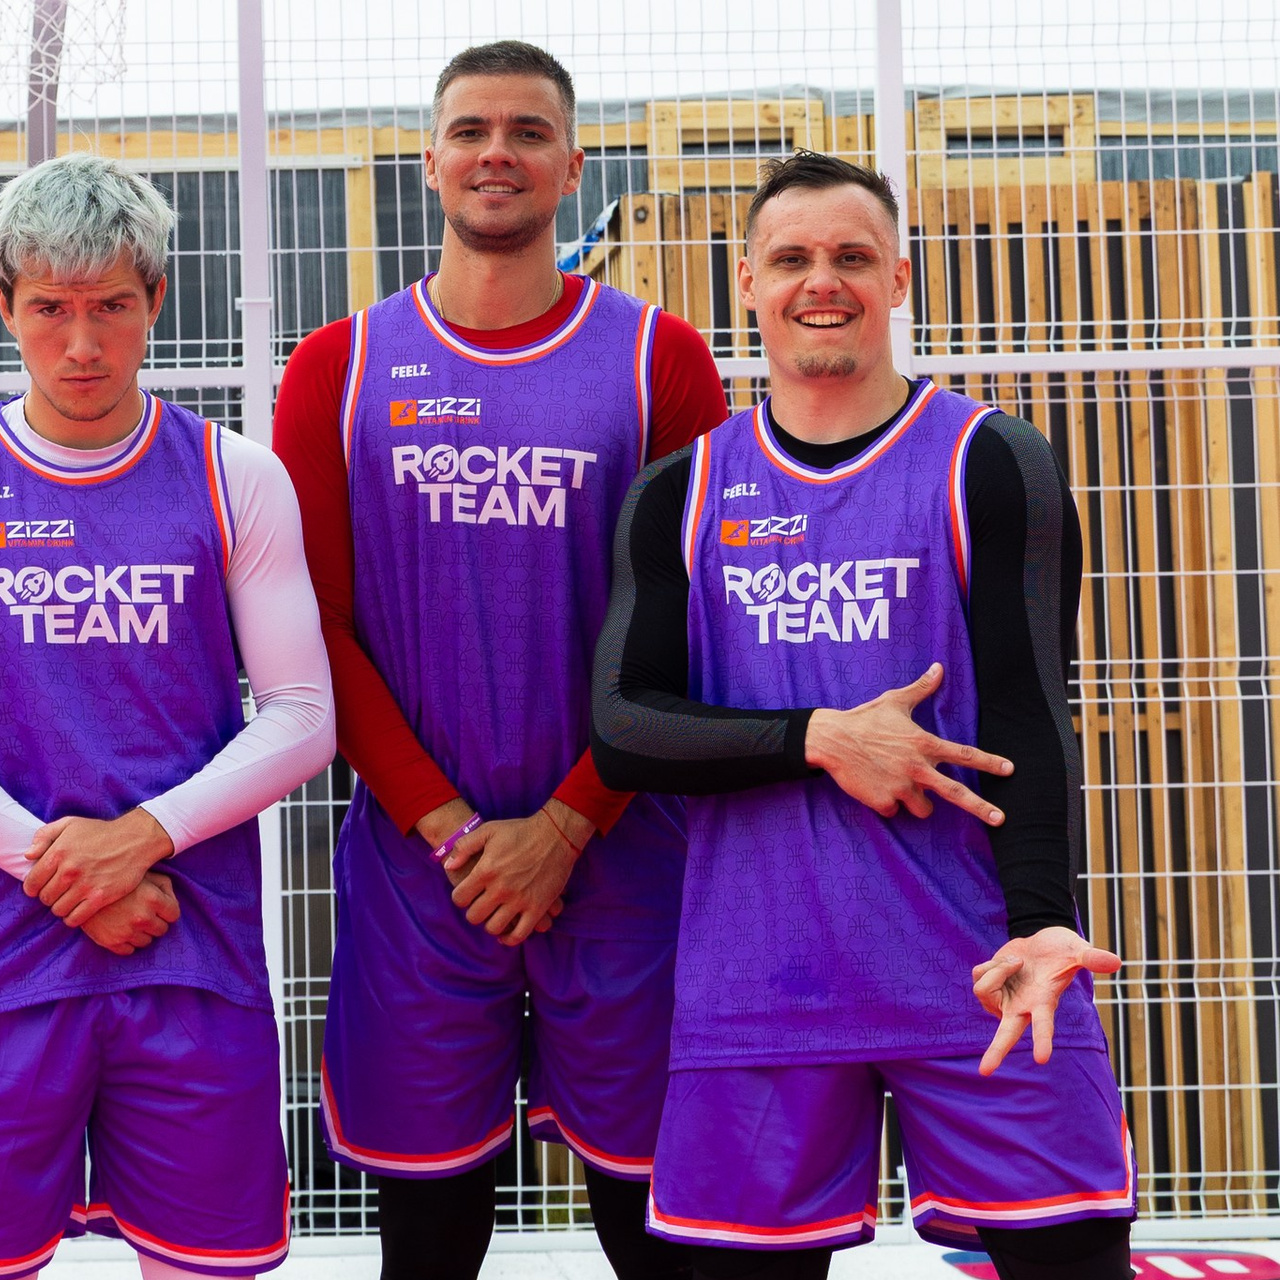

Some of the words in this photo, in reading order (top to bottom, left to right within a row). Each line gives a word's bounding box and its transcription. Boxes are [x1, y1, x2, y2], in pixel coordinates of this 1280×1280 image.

[392, 444, 597, 488] ROCKET
[418, 483, 566, 527] TEAM
[723, 558, 919, 604] ROCKET
[10, 604, 168, 643] TEAM
[746, 599, 889, 644] TEAM
